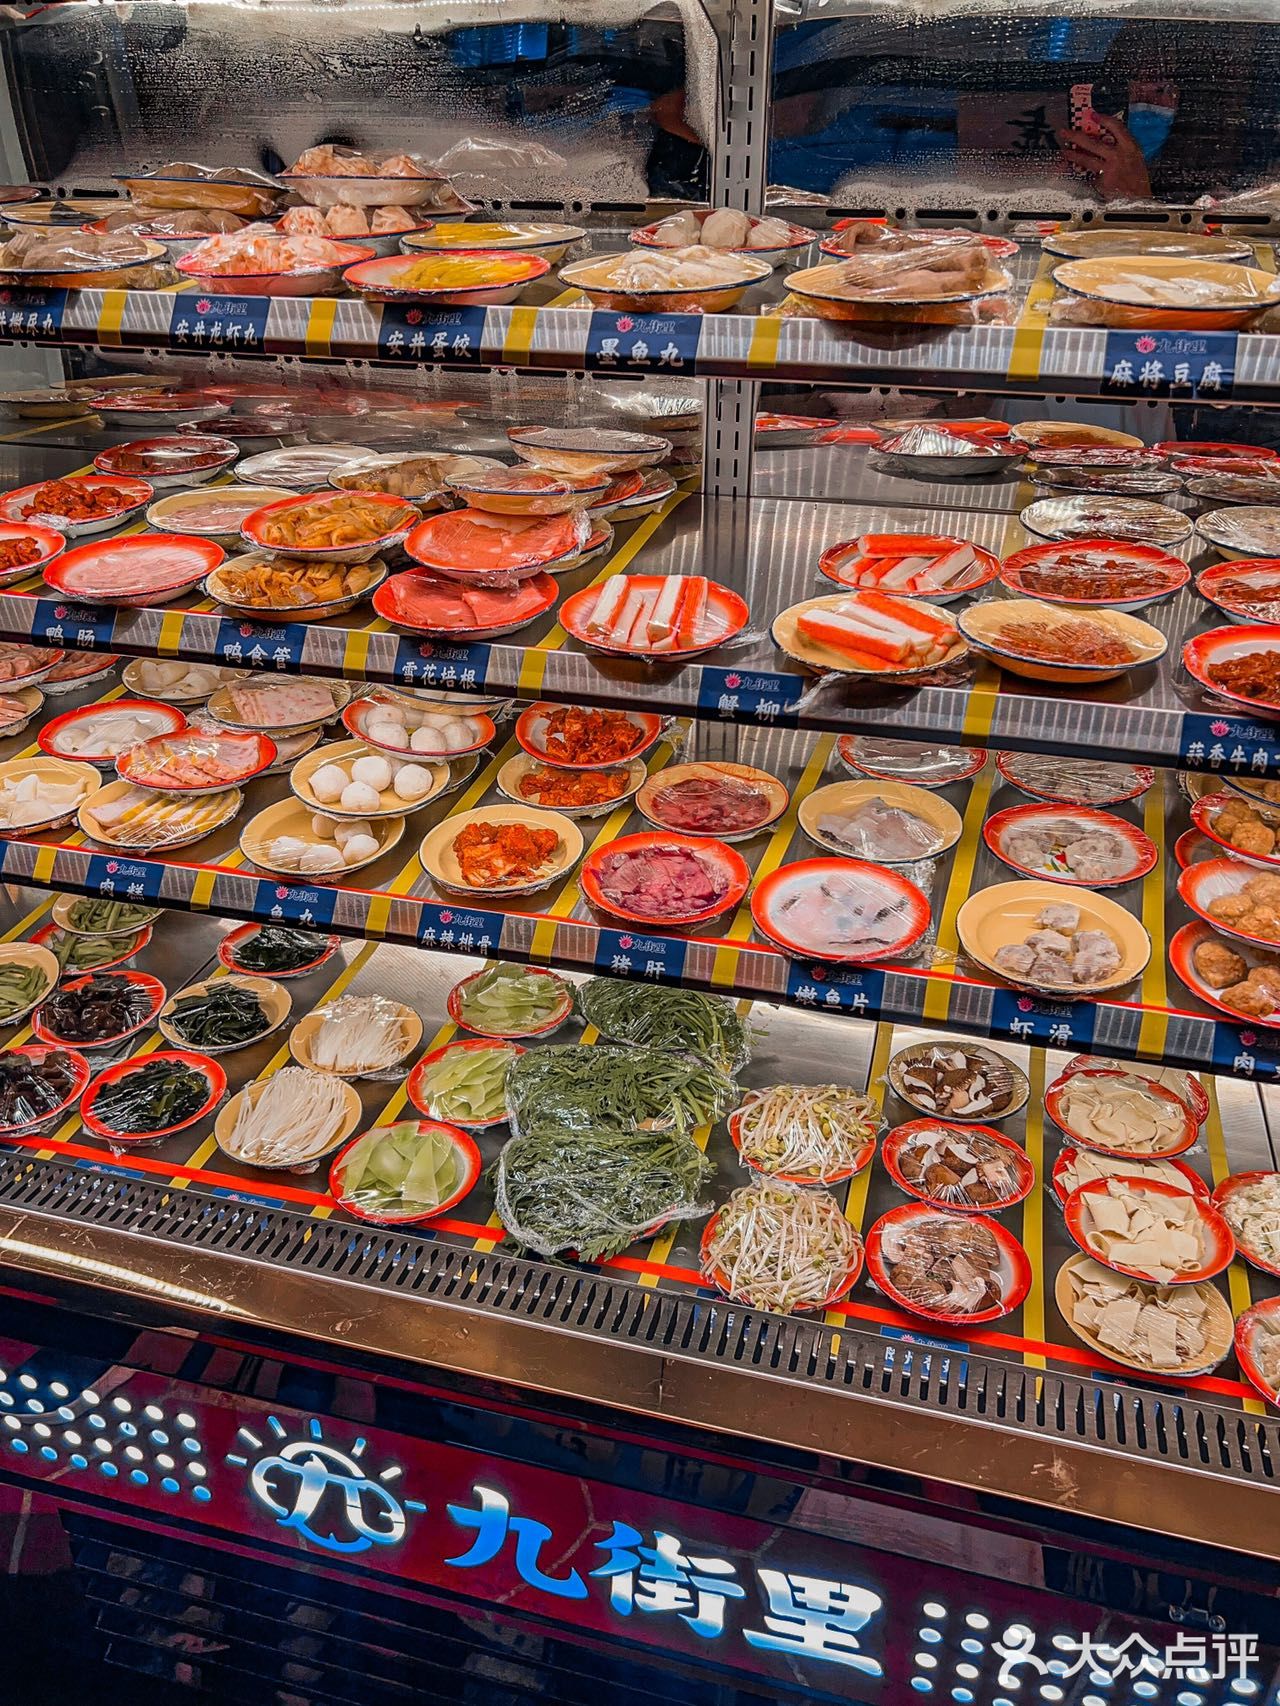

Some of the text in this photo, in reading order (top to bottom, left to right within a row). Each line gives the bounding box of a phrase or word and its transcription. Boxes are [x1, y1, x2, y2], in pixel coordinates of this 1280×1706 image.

[174, 319, 258, 346] 安井龙虾丸
[632, 319, 676, 334] 九街里
[386, 330, 472, 358] 安井蛋饺
[596, 338, 684, 367] 墨鱼丸
[1156, 338, 1207, 354] 九街里
[1108, 359, 1222, 391] 麻将豆腐
[46, 624, 95, 648] 鸭肠
[223, 642, 291, 670] 鸭食管
[402, 661, 477, 690] 雪花培根
[740, 676, 780, 692] 九街里
[718, 693, 780, 723] 蟹柳
[1186, 741, 1280, 774] 蒜香牛肉
[287, 889, 319, 903] 九街里
[268, 904, 317, 927] 鱼丸
[452, 913, 485, 928] 九街里
[421, 926, 492, 955] 麻辣排骨
[632, 939, 666, 954] 九街里
[610, 954, 666, 980] 猪肝
[794, 985, 869, 1014] 嫩鱼片
[1009, 1017, 1073, 1046] 虾滑
[1233, 1051, 1280, 1076] 肉
[444, 1485, 883, 1677] 九街里
